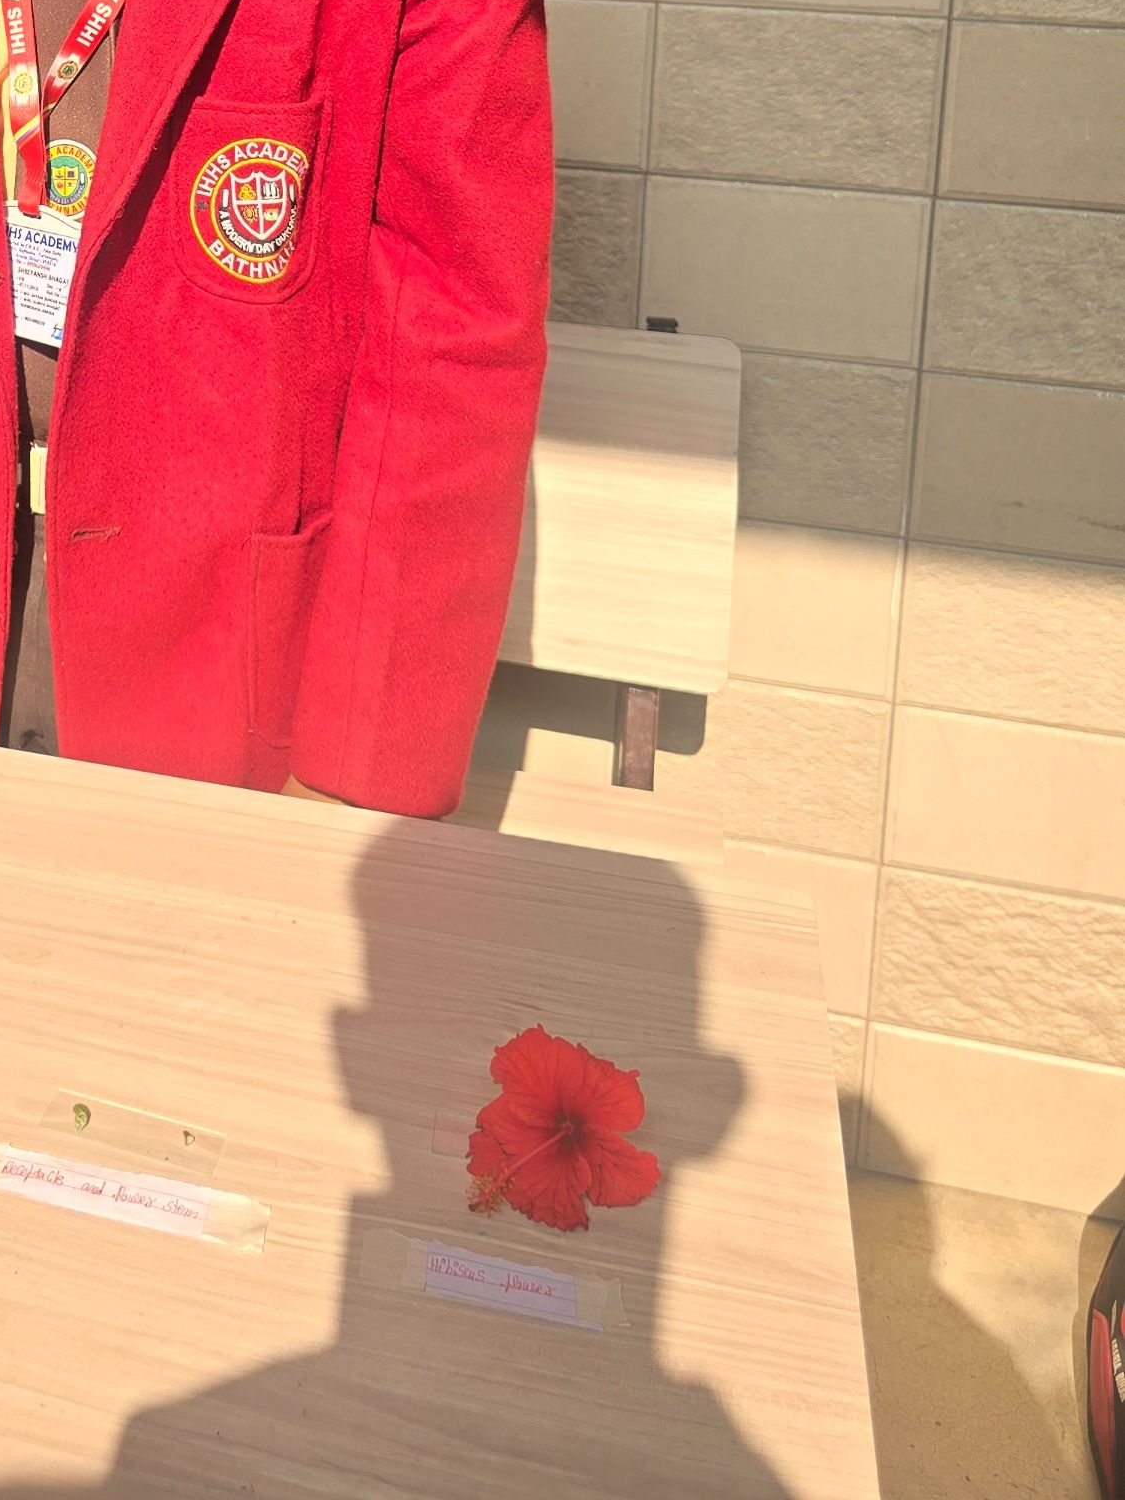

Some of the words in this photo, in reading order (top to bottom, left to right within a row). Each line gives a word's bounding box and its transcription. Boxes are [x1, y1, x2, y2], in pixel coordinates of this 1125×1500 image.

[7, 7, 26, 55] IHHS
[77, 2, 112, 47] IHHS
[197, 154, 231, 197] IHHS
[24, 230, 78, 254] ACADEMY
[80, 1181, 105, 1195] and
